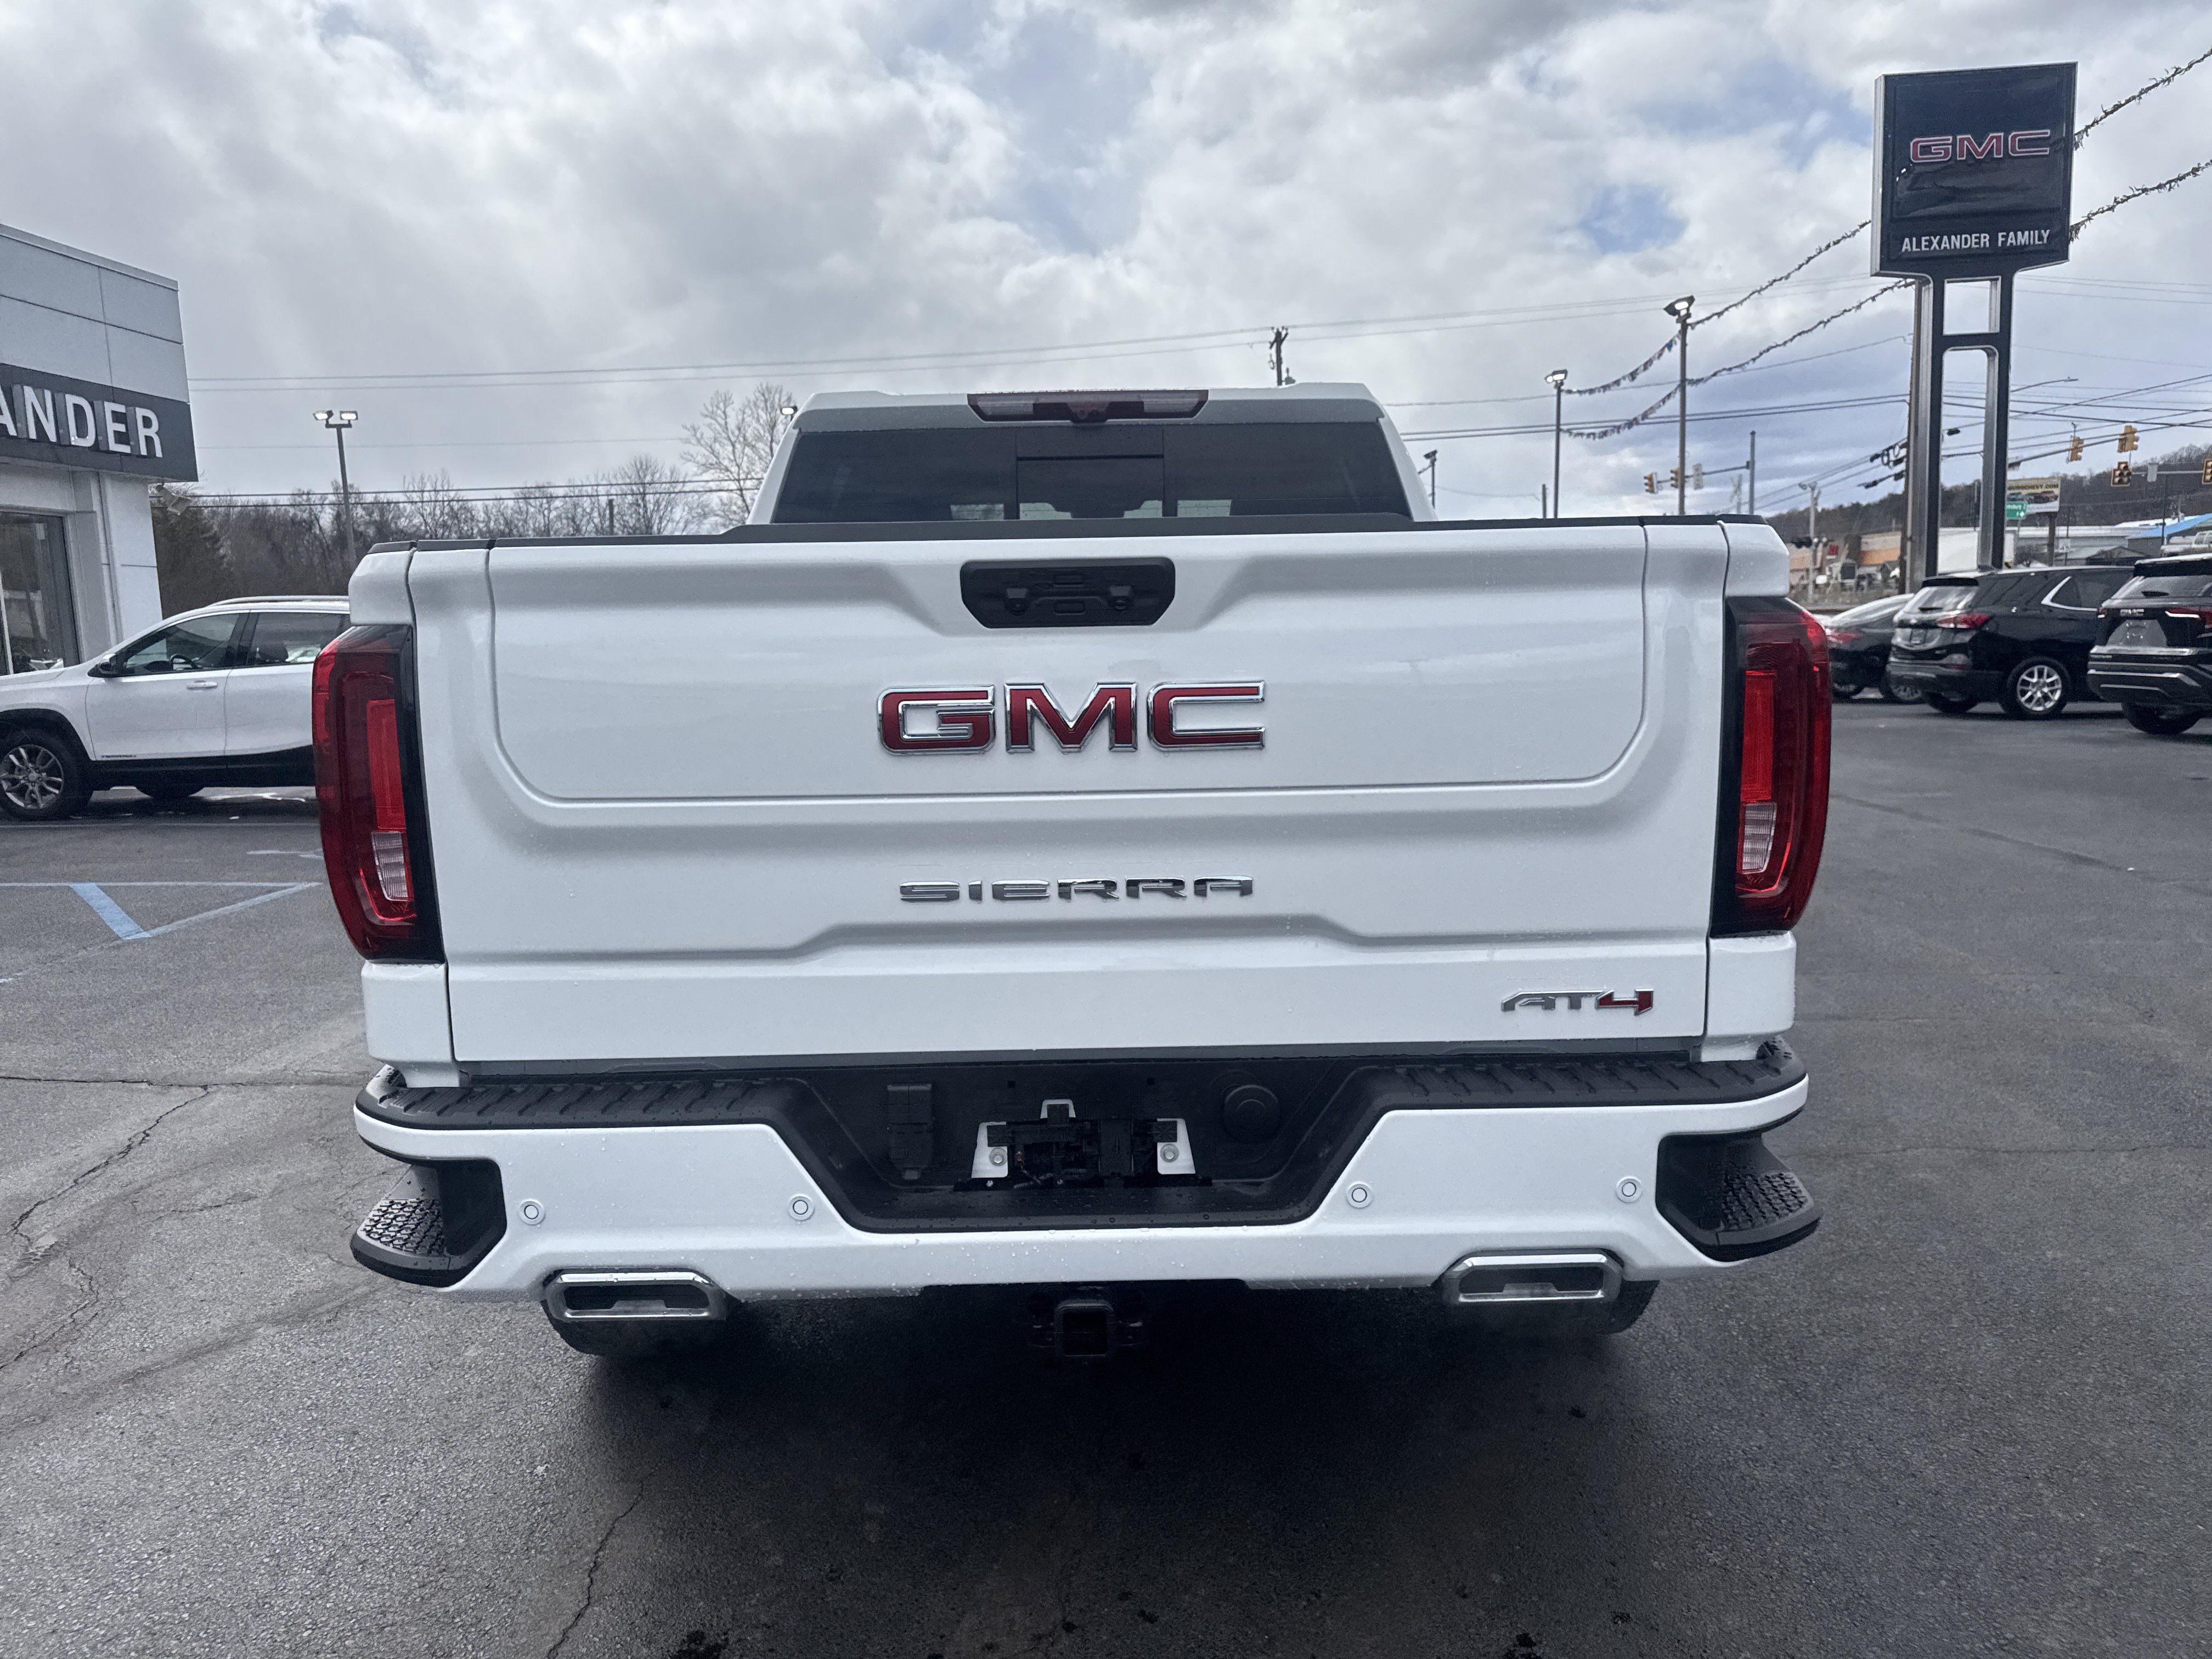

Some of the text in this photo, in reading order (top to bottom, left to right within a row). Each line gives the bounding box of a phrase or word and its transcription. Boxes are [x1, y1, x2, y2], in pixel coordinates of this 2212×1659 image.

[1910, 129, 2051, 163] GMC
[1901, 229, 2050, 252] ALEXANDER FAMILY
[878, 681, 1265, 754] GMC
[899, 876, 1254, 902] SIERRA
[1501, 988, 1654, 1015] AT4
